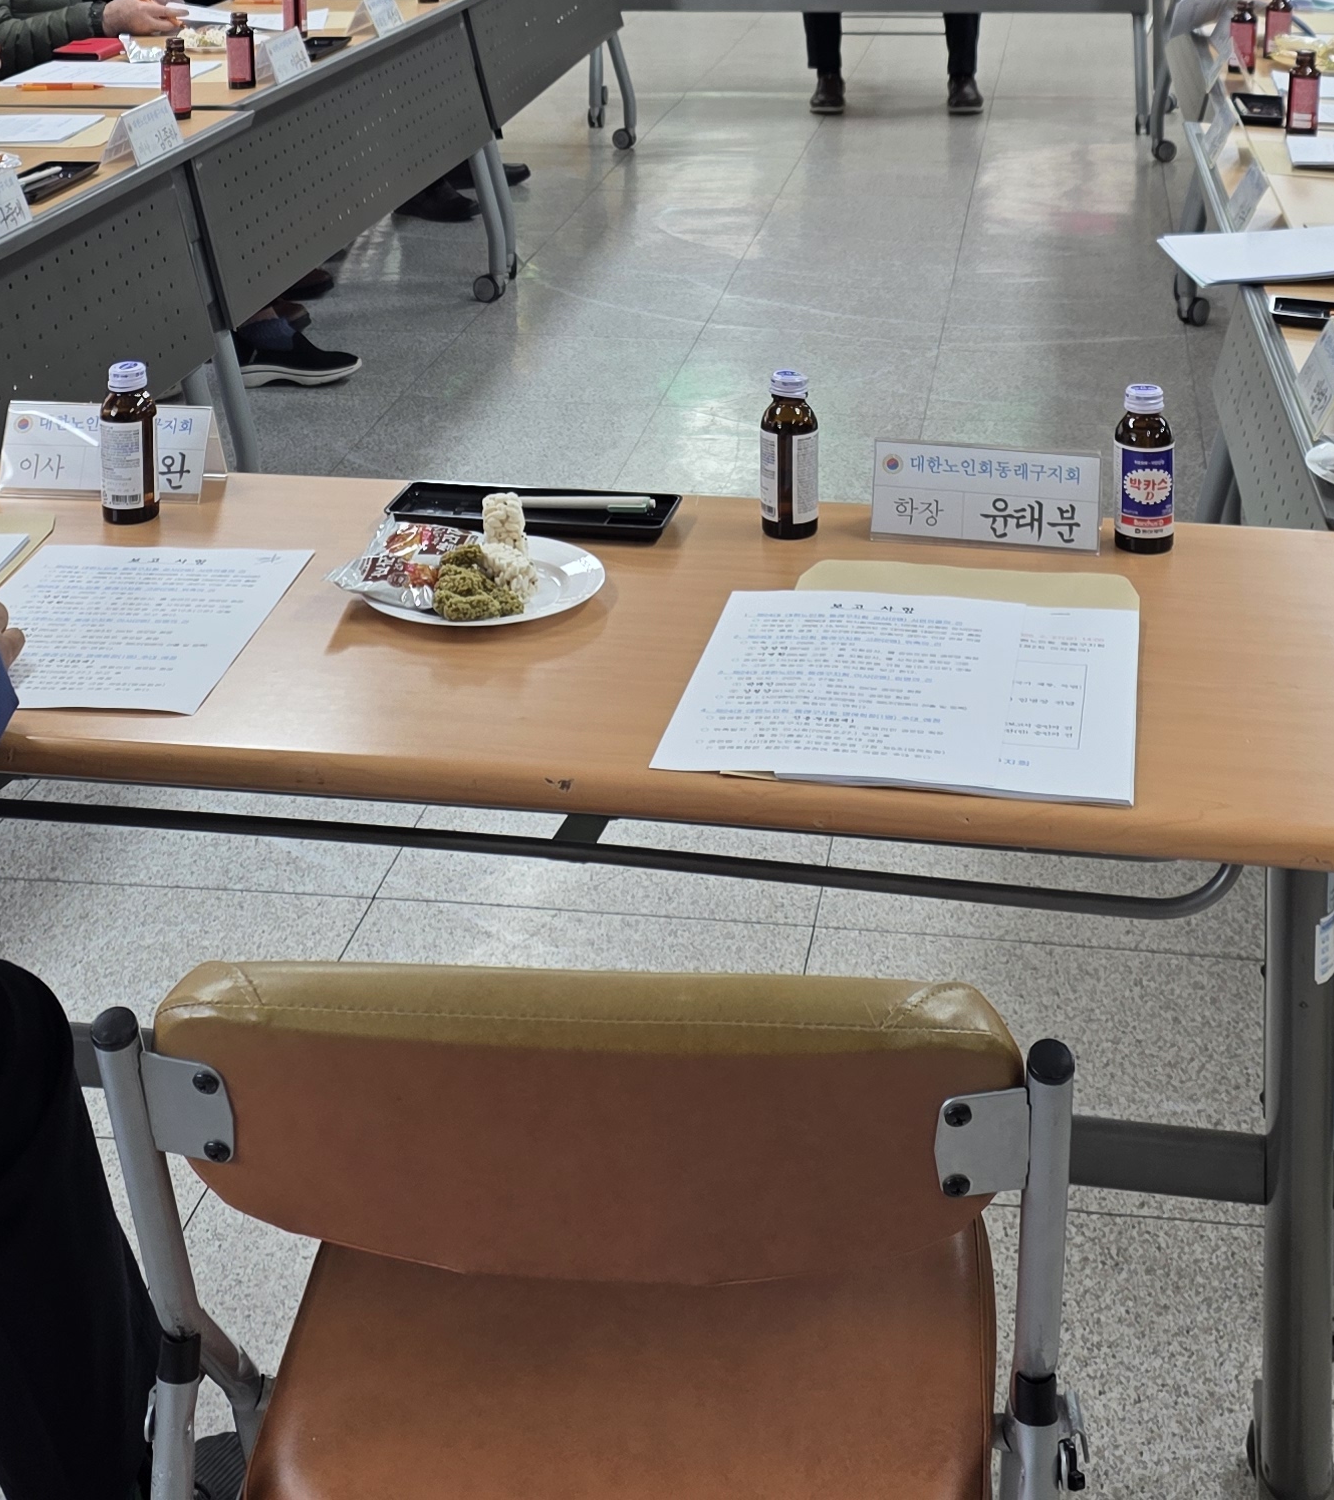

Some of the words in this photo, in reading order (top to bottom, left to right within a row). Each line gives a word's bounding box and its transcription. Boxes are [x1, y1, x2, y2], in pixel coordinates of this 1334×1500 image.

[19, 453, 66, 480] 이사
[910, 454, 1081, 486] 대한노인회동래구지회
[1129, 477, 1169, 492] 박카스
[1144, 491, 1155, 501] D
[893, 497, 945, 527] 학장
[979, 497, 1082, 544] 윤태분
